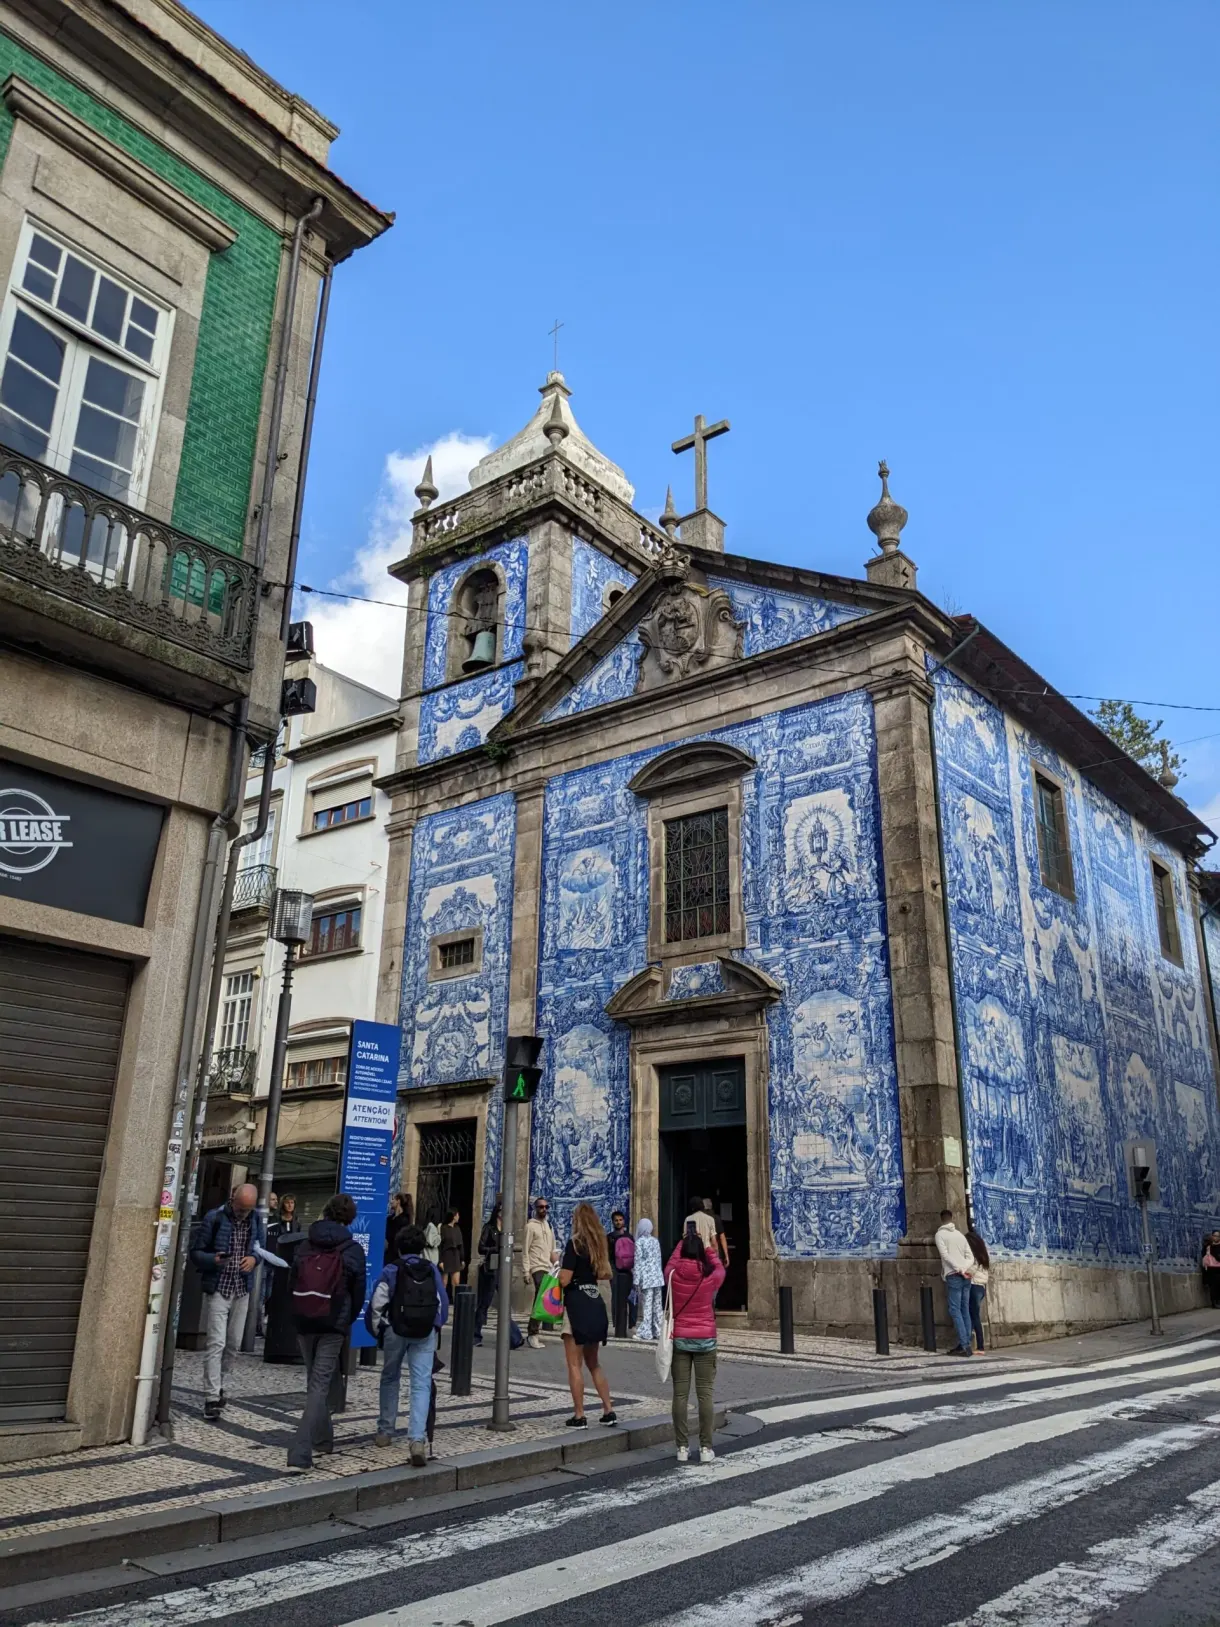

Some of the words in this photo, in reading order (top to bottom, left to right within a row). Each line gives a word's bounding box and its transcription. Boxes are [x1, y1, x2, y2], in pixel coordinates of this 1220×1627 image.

[9, 821, 63, 841] LEASE
[358, 1040, 379, 1051] SANTA
[356, 1051, 390, 1063] CATARINA
[352, 1104, 391, 1116] ATENÇÃO!
[353, 1116, 388, 1125] ATTENTION!
